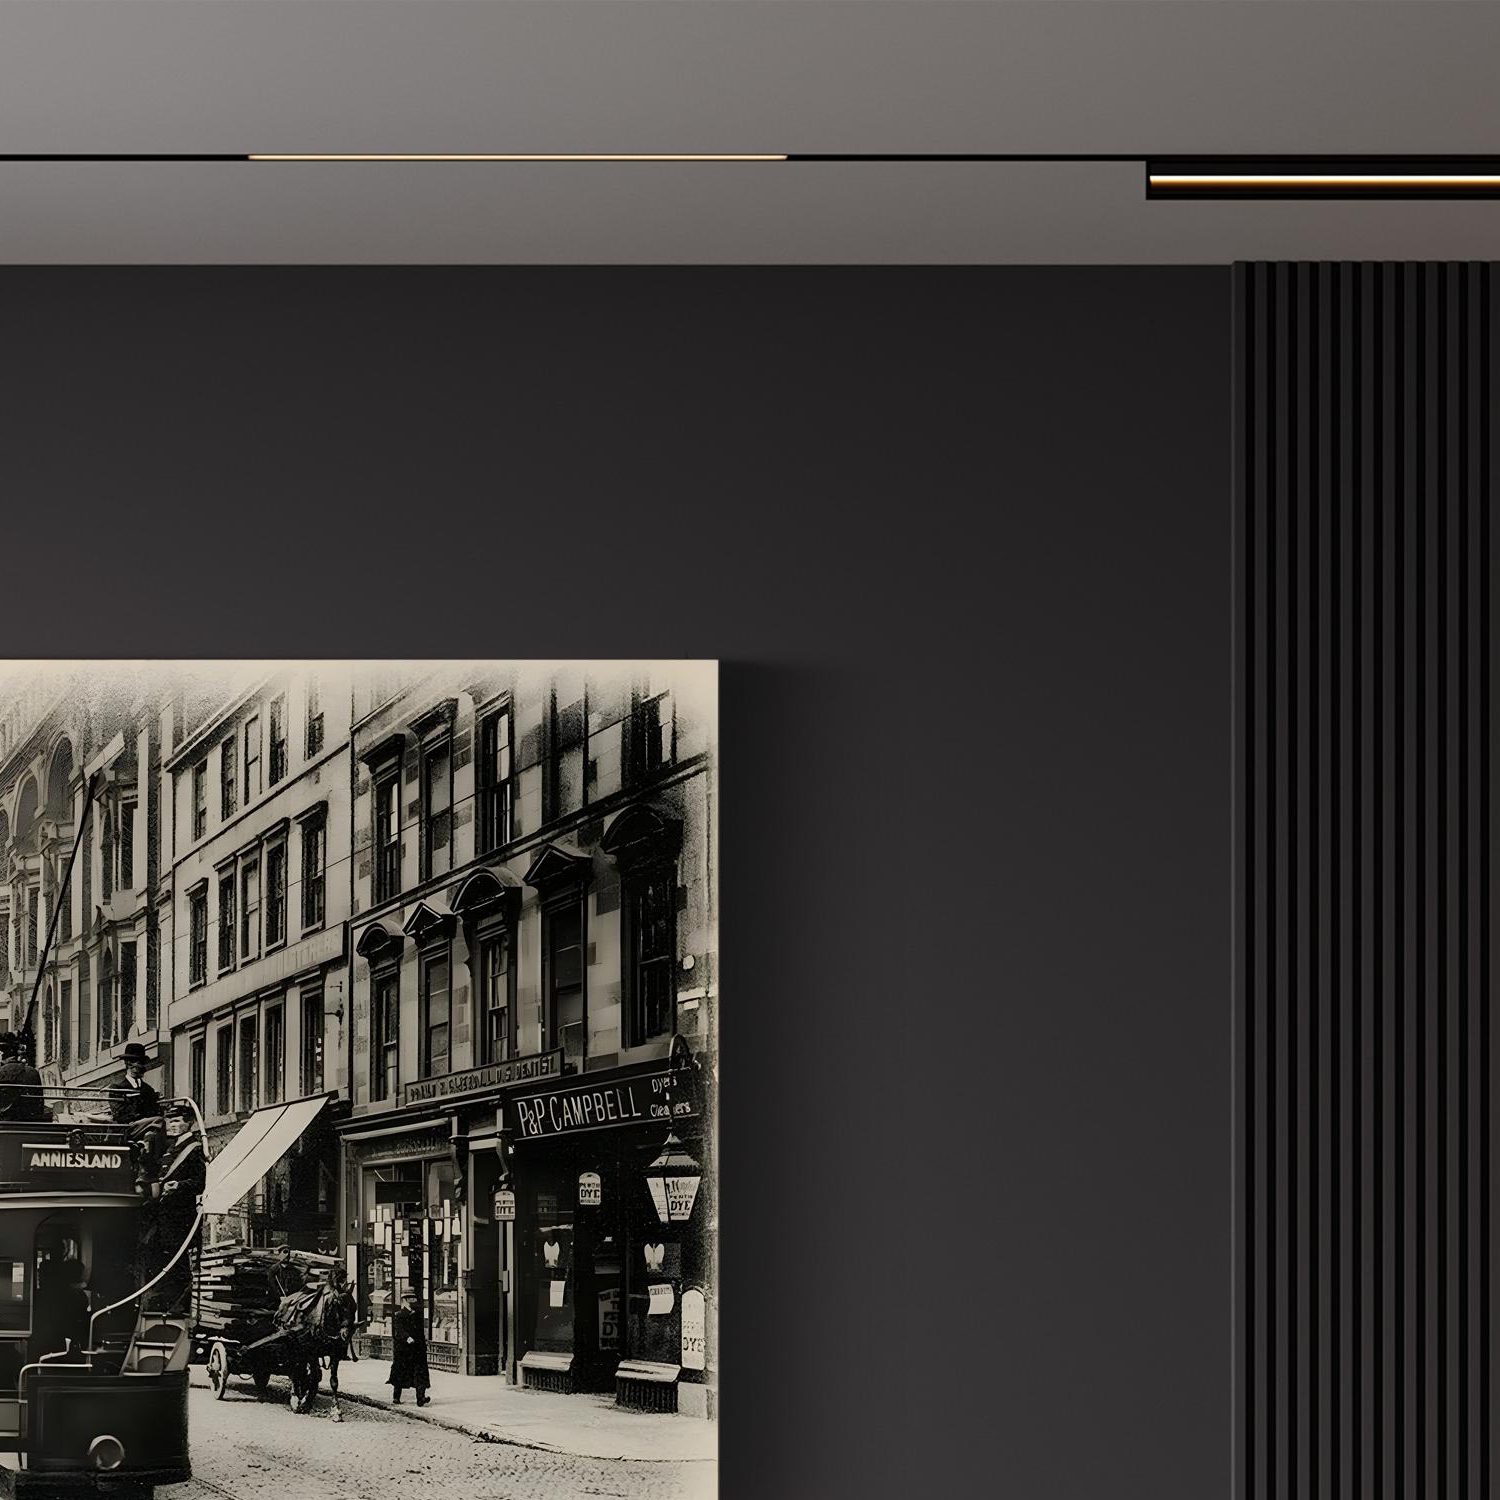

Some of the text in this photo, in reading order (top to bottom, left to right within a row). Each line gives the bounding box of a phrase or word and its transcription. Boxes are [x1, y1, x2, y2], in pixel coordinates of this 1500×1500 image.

[549, 1086, 642, 1132] CAMPBELL
[30, 1152, 122, 1169] ANNIESLAND
[670, 1201, 691, 1211] DYE
